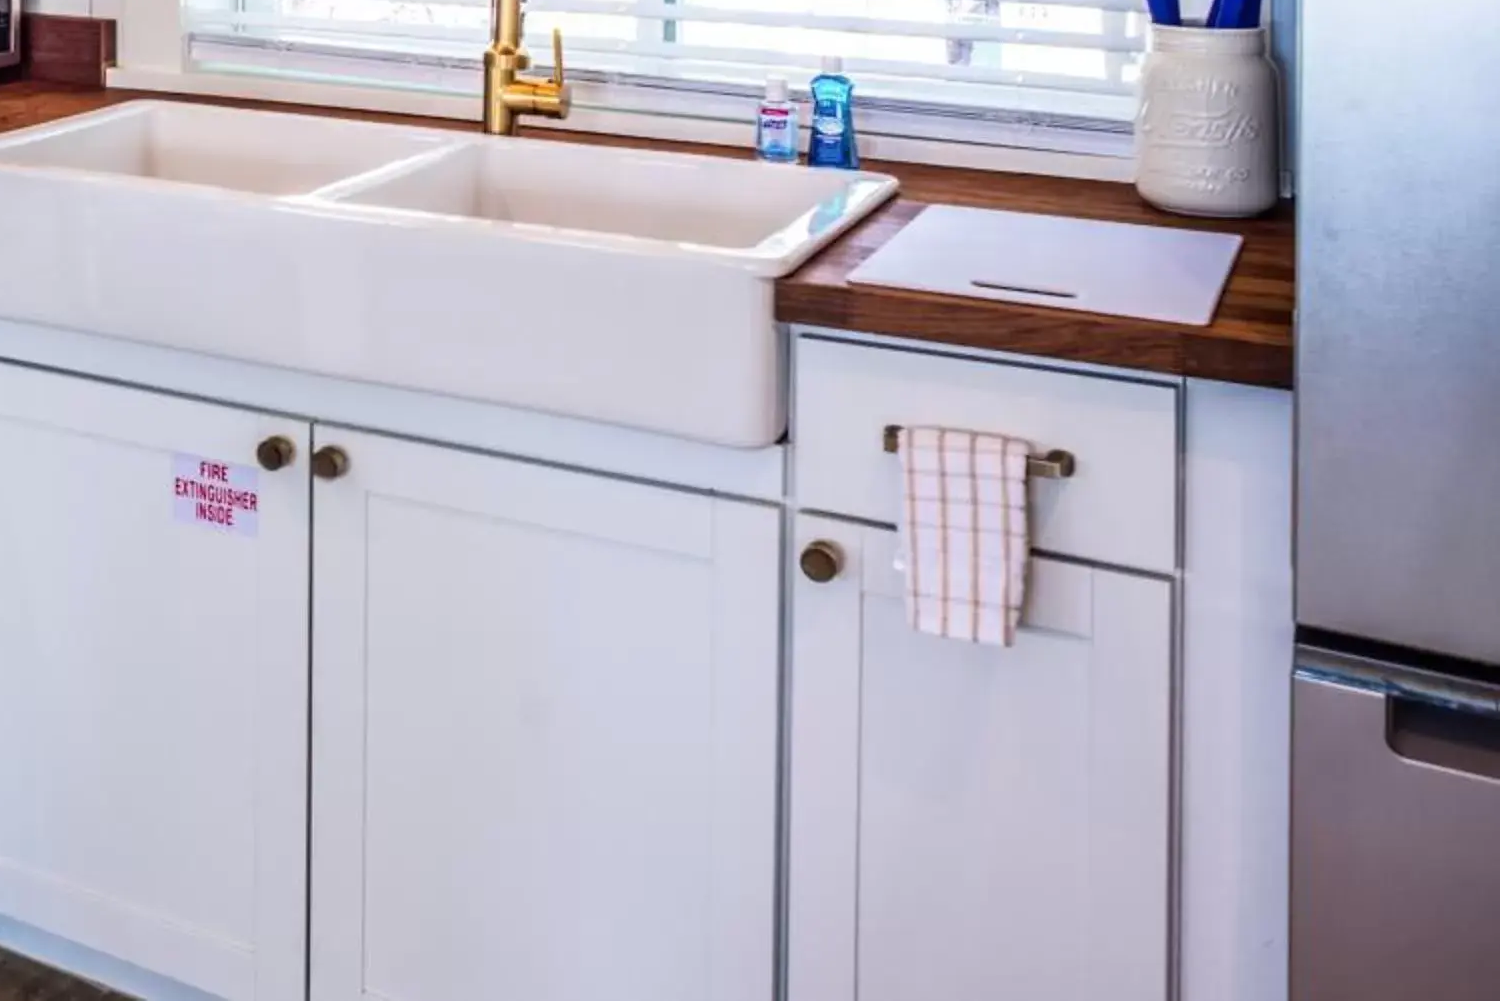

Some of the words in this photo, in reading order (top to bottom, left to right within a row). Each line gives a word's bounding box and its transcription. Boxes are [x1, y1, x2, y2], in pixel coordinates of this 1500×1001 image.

[199, 461, 229, 482] FIRE
[175, 477, 257, 511] EXTINGUISHER
[195, 502, 233, 526] INSIDE
